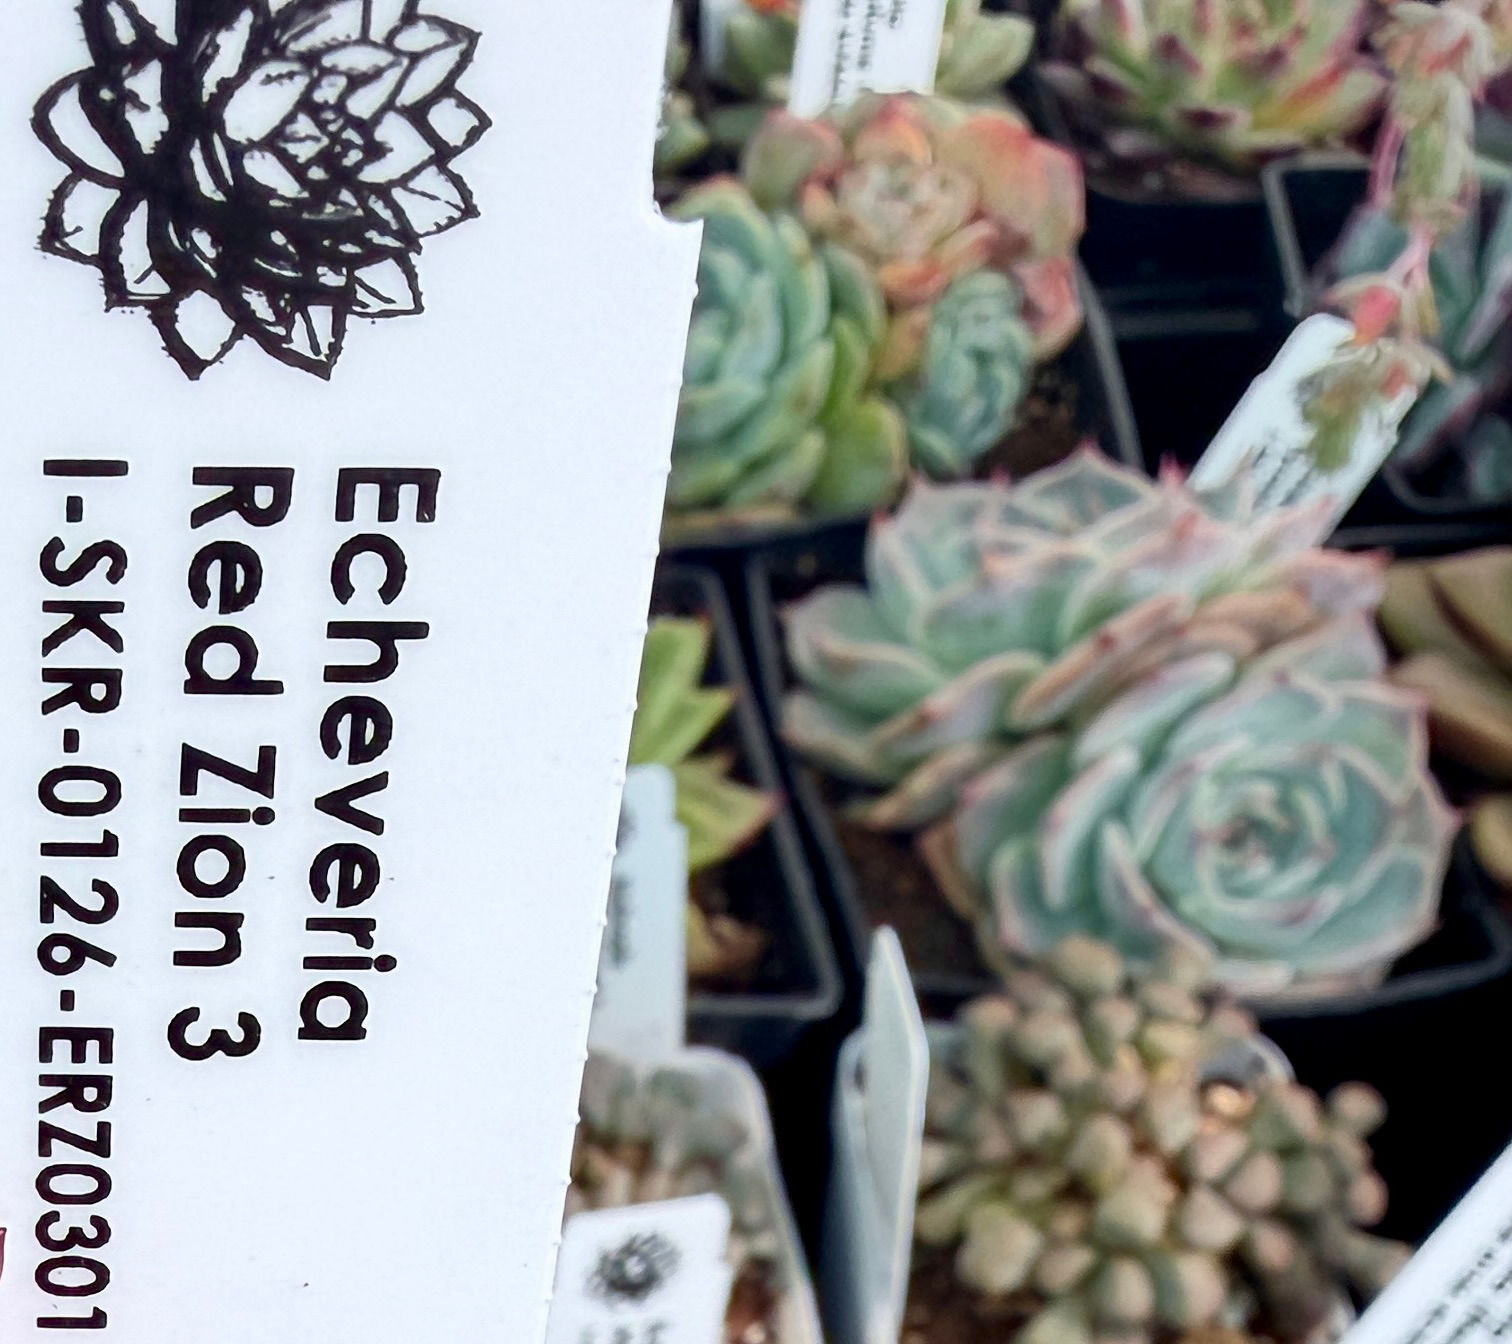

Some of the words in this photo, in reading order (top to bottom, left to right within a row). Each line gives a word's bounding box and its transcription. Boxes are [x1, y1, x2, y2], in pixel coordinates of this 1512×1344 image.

[182, 465, 296, 697] Red
[171, 741, 278, 969] Zion
[296, 466, 443, 1042] Echeveria
[33, 458, 130, 1331] I-SKR-0126-ERZ0301
[166, 1005, 263, 1063] 3
